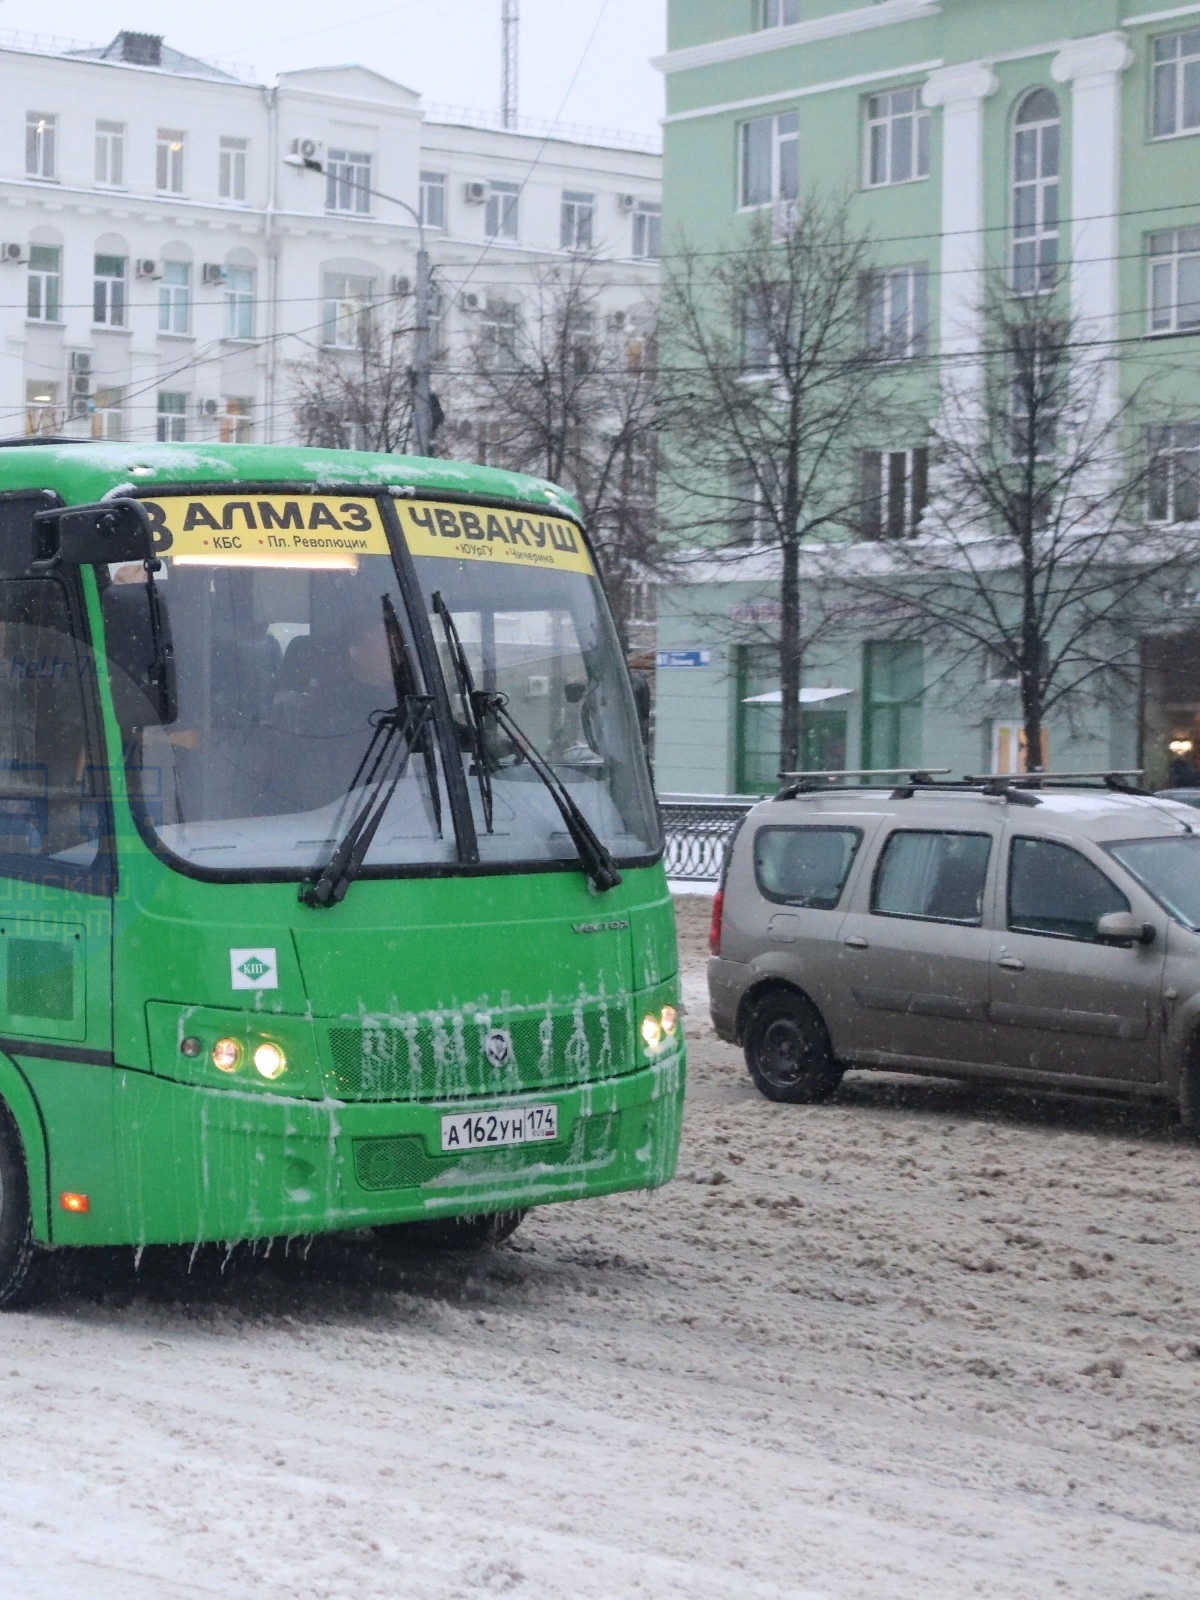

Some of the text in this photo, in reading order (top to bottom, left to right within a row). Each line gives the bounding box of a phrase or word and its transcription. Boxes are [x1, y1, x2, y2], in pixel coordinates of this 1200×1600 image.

[183, 502, 372, 532] АЛМАЗ
[408, 507, 579, 553] ЧВВАКУШ
[213, 536, 368, 549] КБС Пл. Революции
[460, 543, 555, 564] ЮУрГУ Чичерина
[527, 1108, 553, 1130] 174
[532, 1129, 544, 1137] RUS
